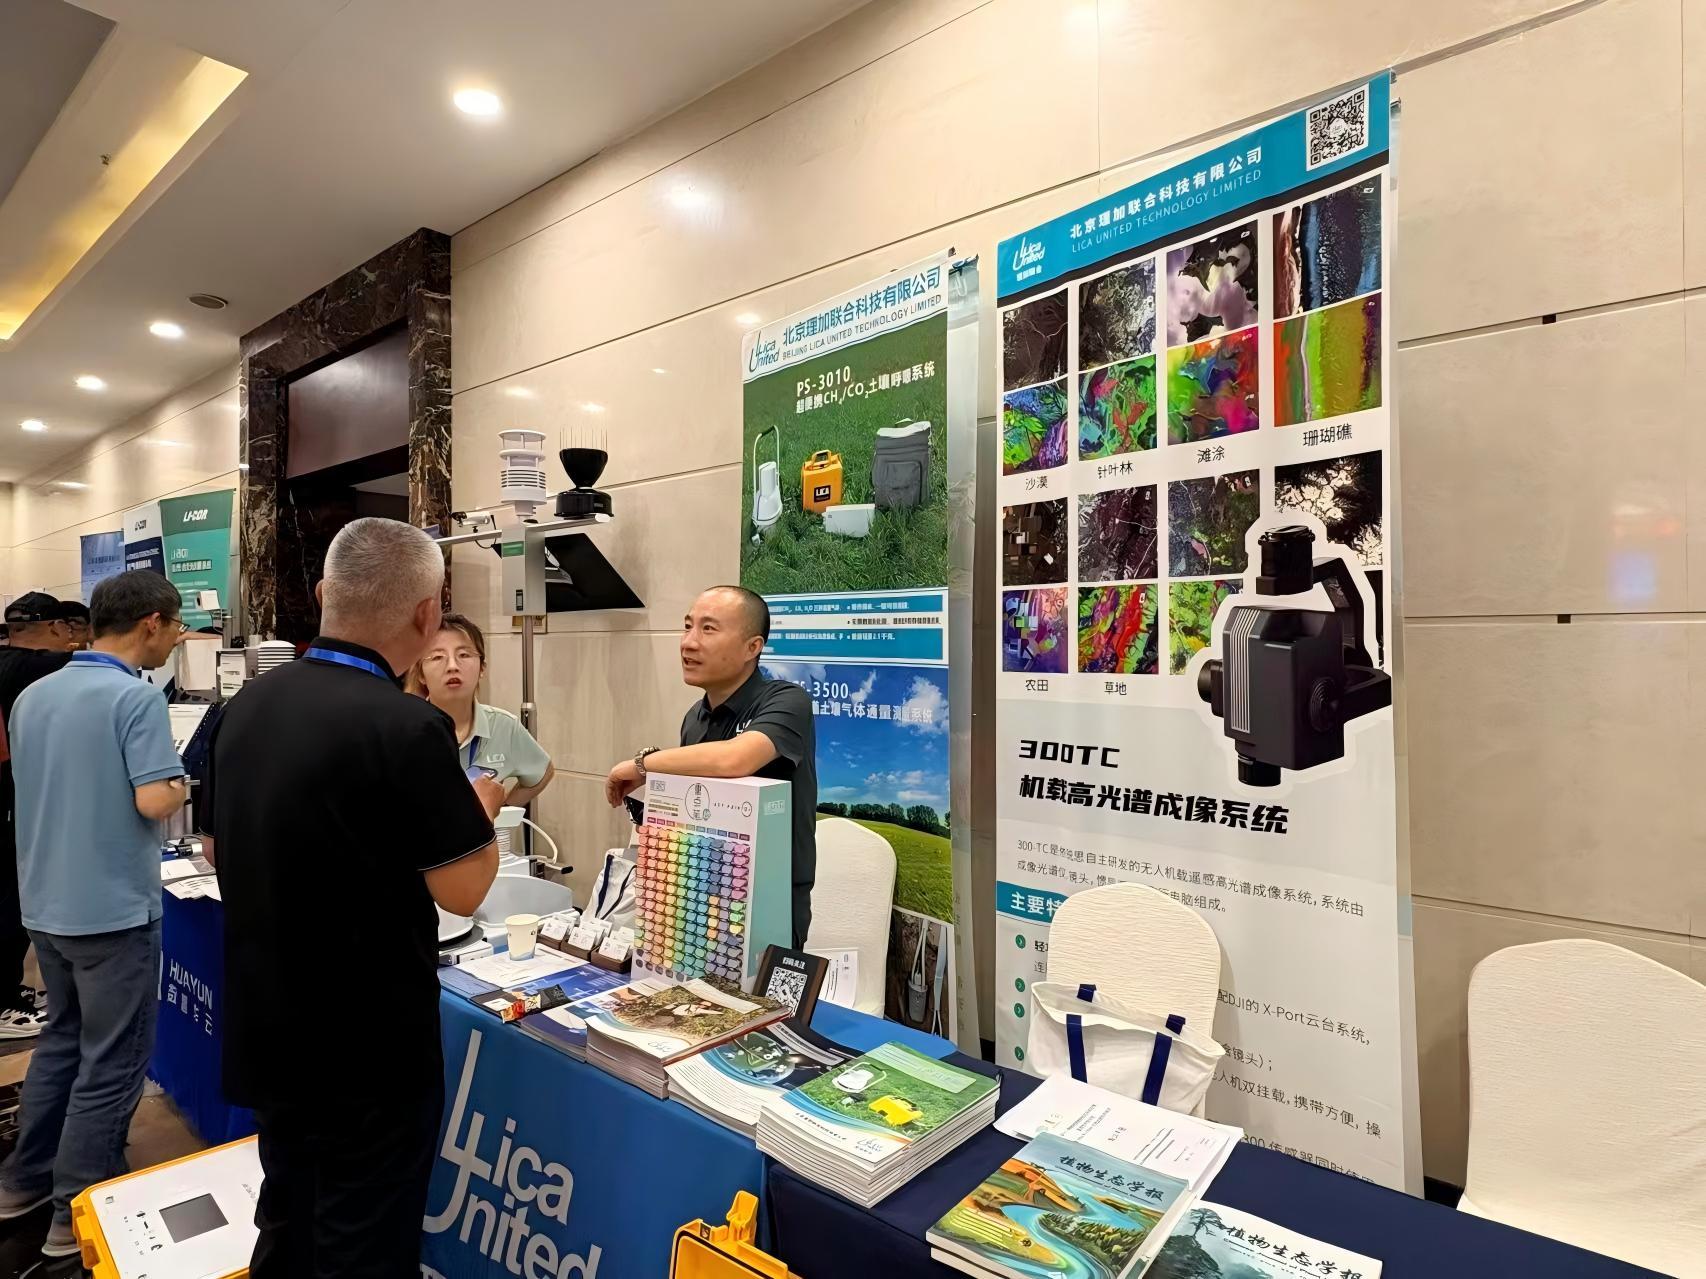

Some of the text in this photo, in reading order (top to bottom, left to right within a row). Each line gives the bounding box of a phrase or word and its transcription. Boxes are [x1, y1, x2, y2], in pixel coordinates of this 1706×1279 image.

[1070, 146, 1262, 240] 北京理加联合科技有限公司
[1072, 169, 1262, 253] LICA UNITED TECHNOLOGY LIMITED
[783, 265, 940, 345] 北京理加联合科技有限公司
[809, 339, 826, 351] LICA
[826, 328, 852, 345] UNITED
[855, 307, 908, 334] TECHNOLOGY
[910, 294, 942, 314] LIMITED
[797, 366, 851, 397] PS-3010
[1303, 424, 1353, 446] 珊瑚礁
[1098, 462, 1133, 478] 针叶林
[1197, 446, 1225, 463] 滩涂
[1025, 478, 1049, 490] 沙漠
[1025, 679, 1049, 692] 农田
[1104, 681, 1127, 696] 草地
[1019, 739, 1120, 769] 300TC
[1019, 774, 1289, 834] 机载高光谱成像系统
[169, 958, 213, 1010] HUAYUN
[440, 1028, 574, 1226] Lica
[1060, 1156, 1163, 1202] 植物生态学报
